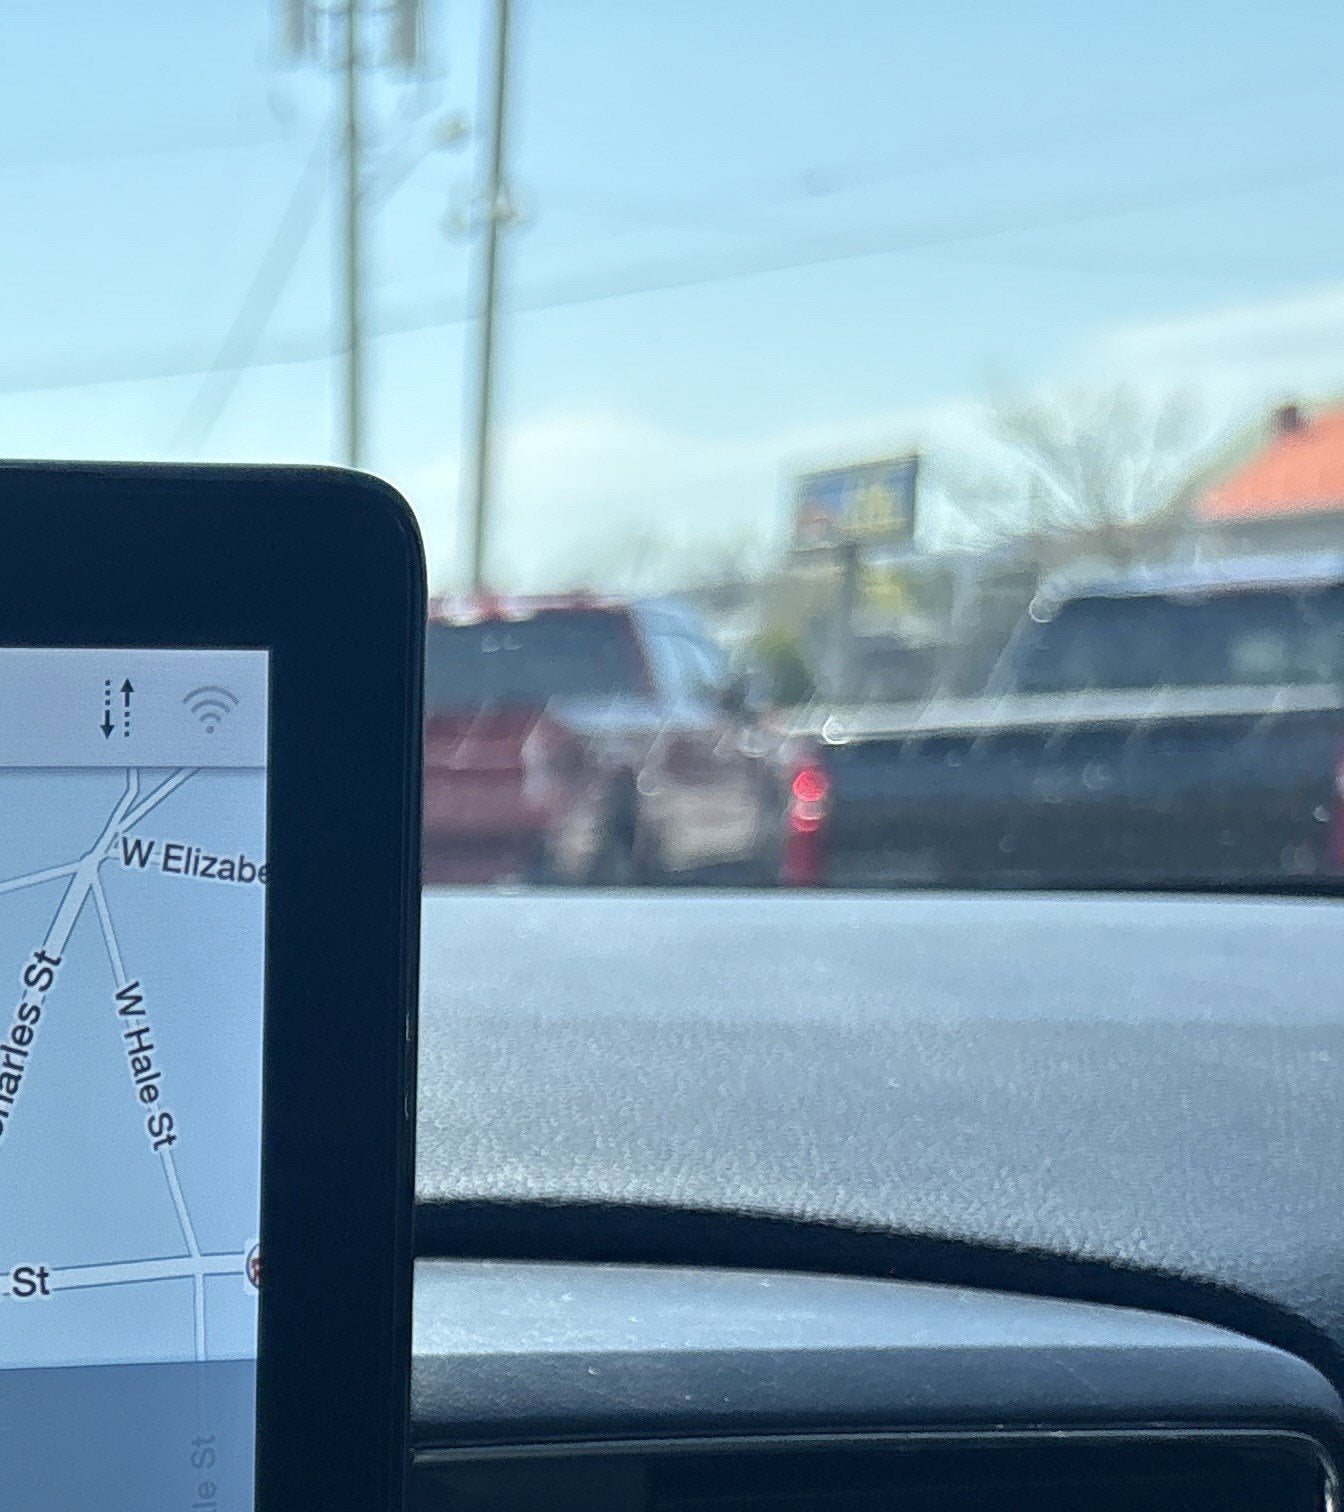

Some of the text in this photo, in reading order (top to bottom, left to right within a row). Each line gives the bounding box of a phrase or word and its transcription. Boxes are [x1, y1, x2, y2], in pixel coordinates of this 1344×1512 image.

[122, 836, 155, 868] W
[23, 949, 62, 993] St
[115, 980, 177, 1151] W Hale St
[12, 1265, 51, 1296] St
